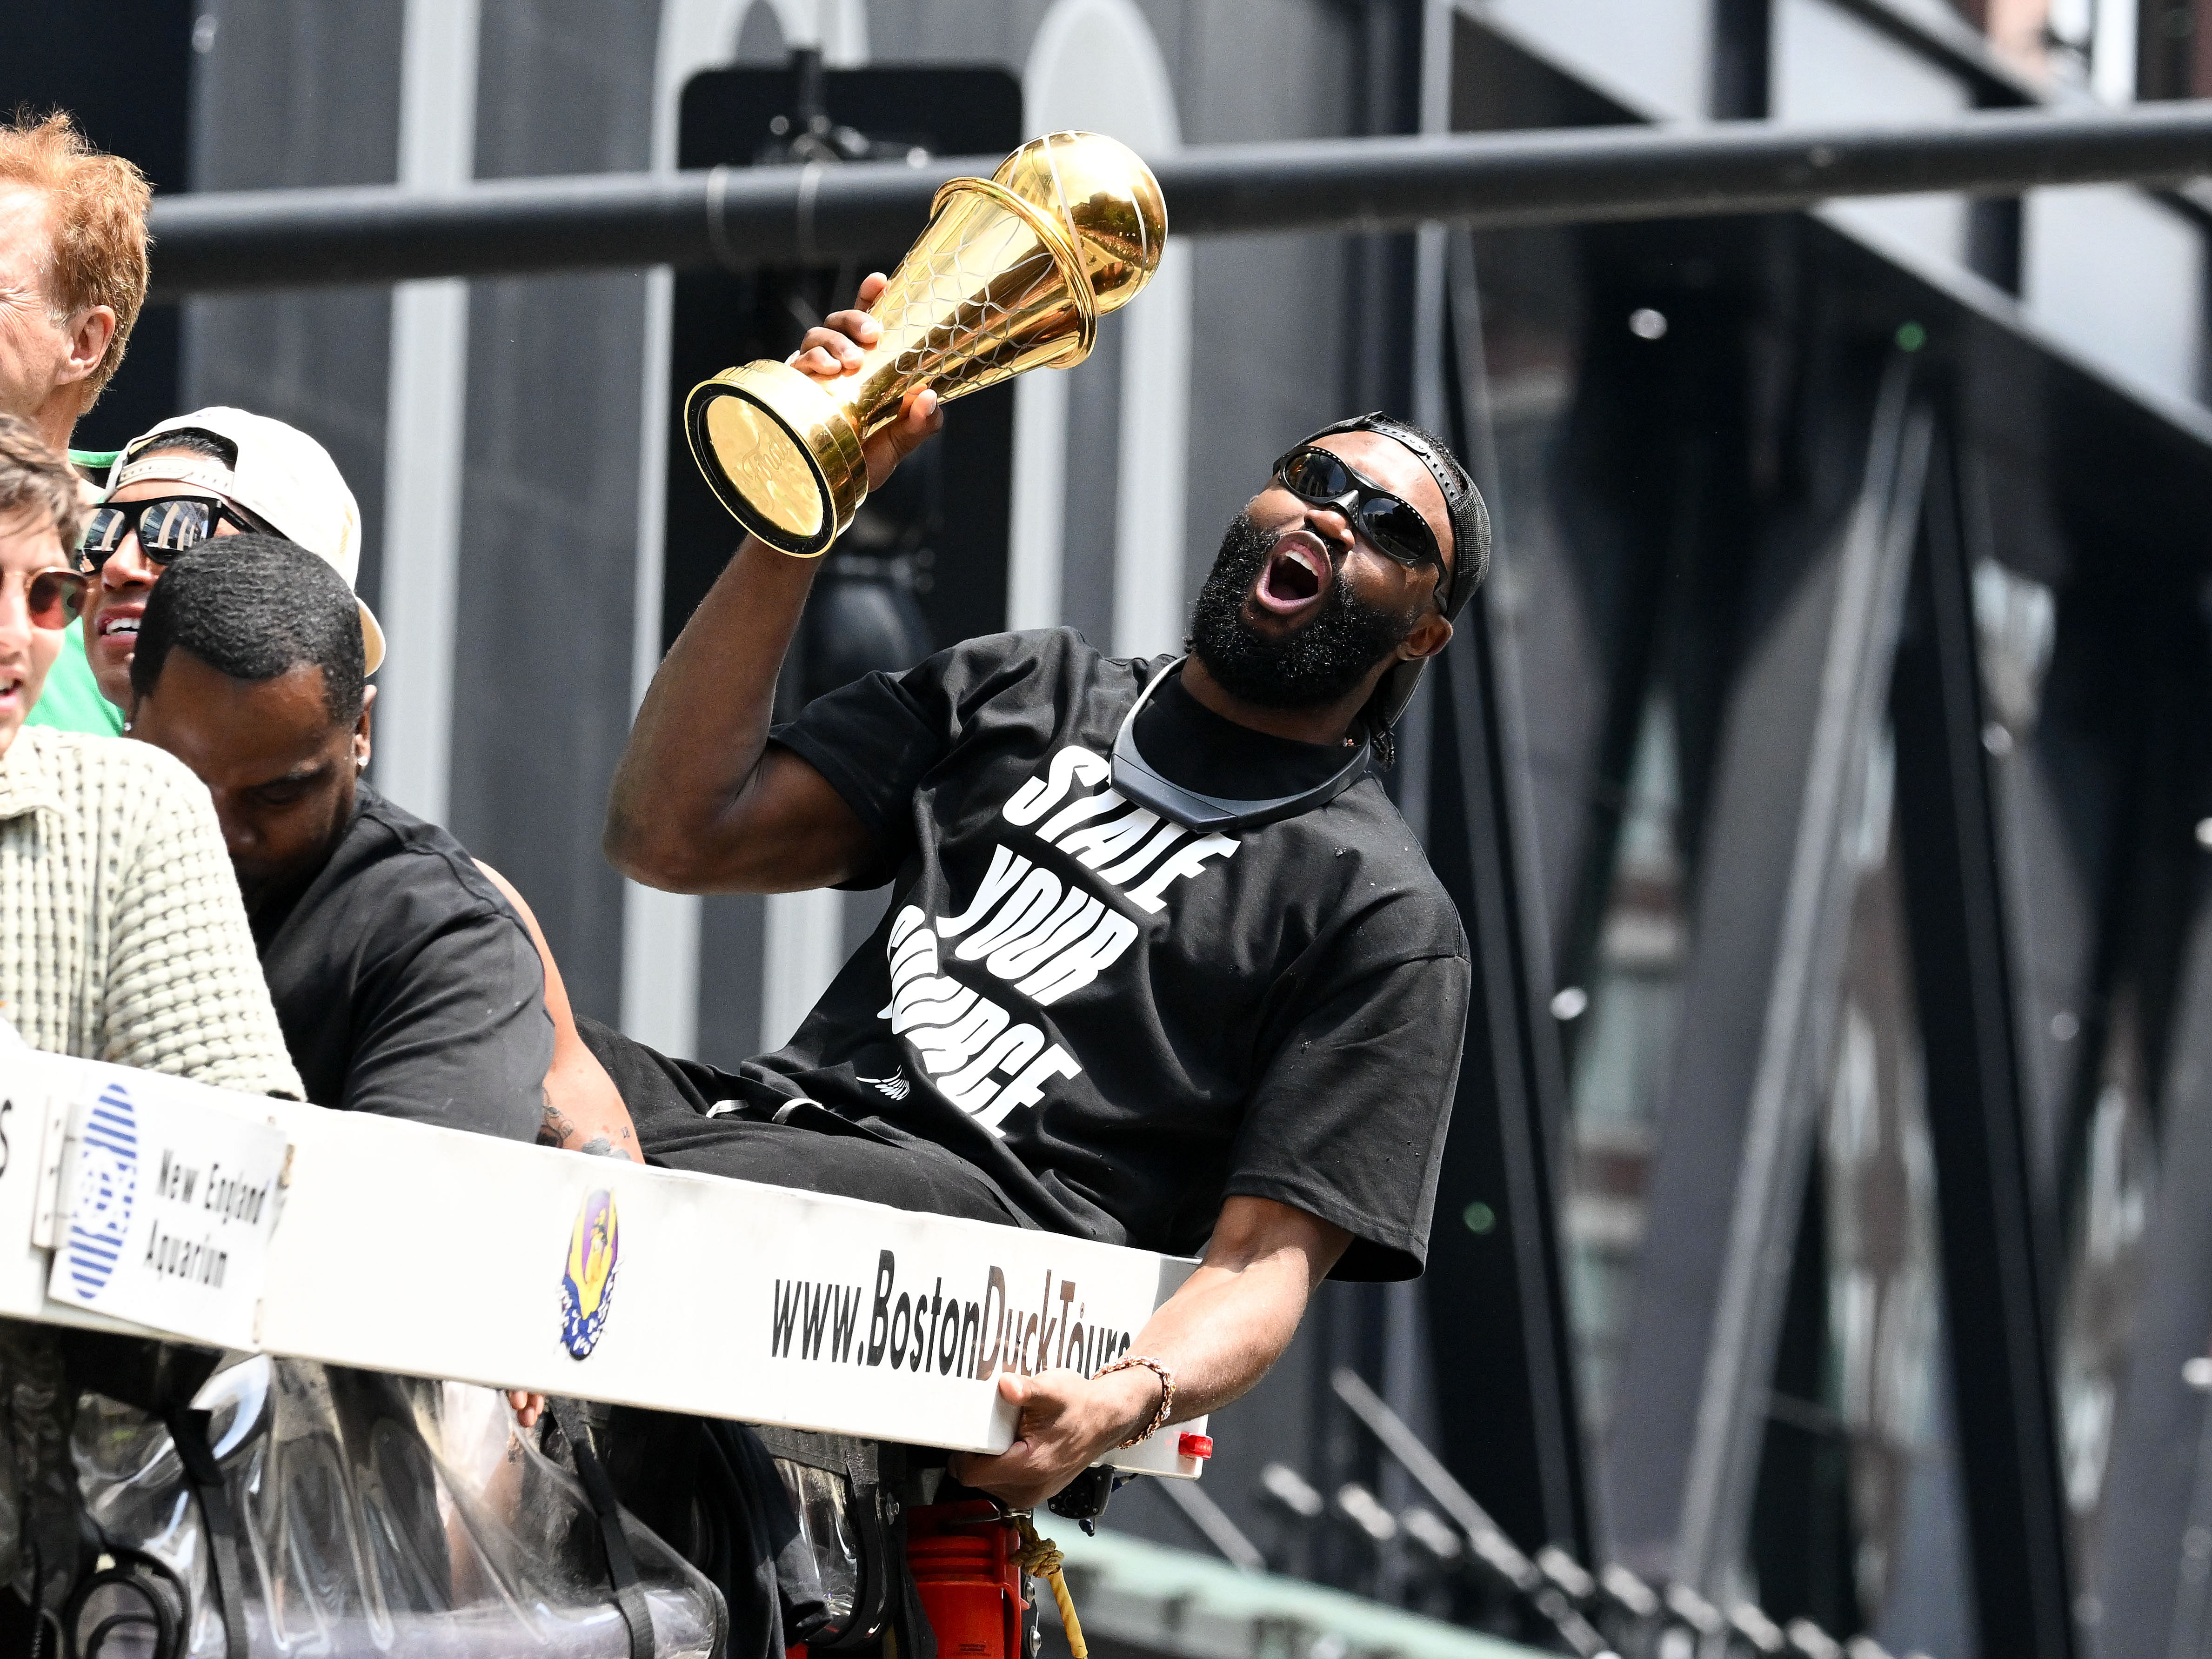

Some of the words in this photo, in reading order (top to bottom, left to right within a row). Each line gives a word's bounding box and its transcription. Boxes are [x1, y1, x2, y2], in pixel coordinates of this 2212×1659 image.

[1002, 745, 1241, 914] STATE
[936, 843, 1139, 1006] YOUR
[156, 1148, 199, 1203] New
[204, 1163, 269, 1225] England
[144, 1218, 227, 1288] Aquarium
